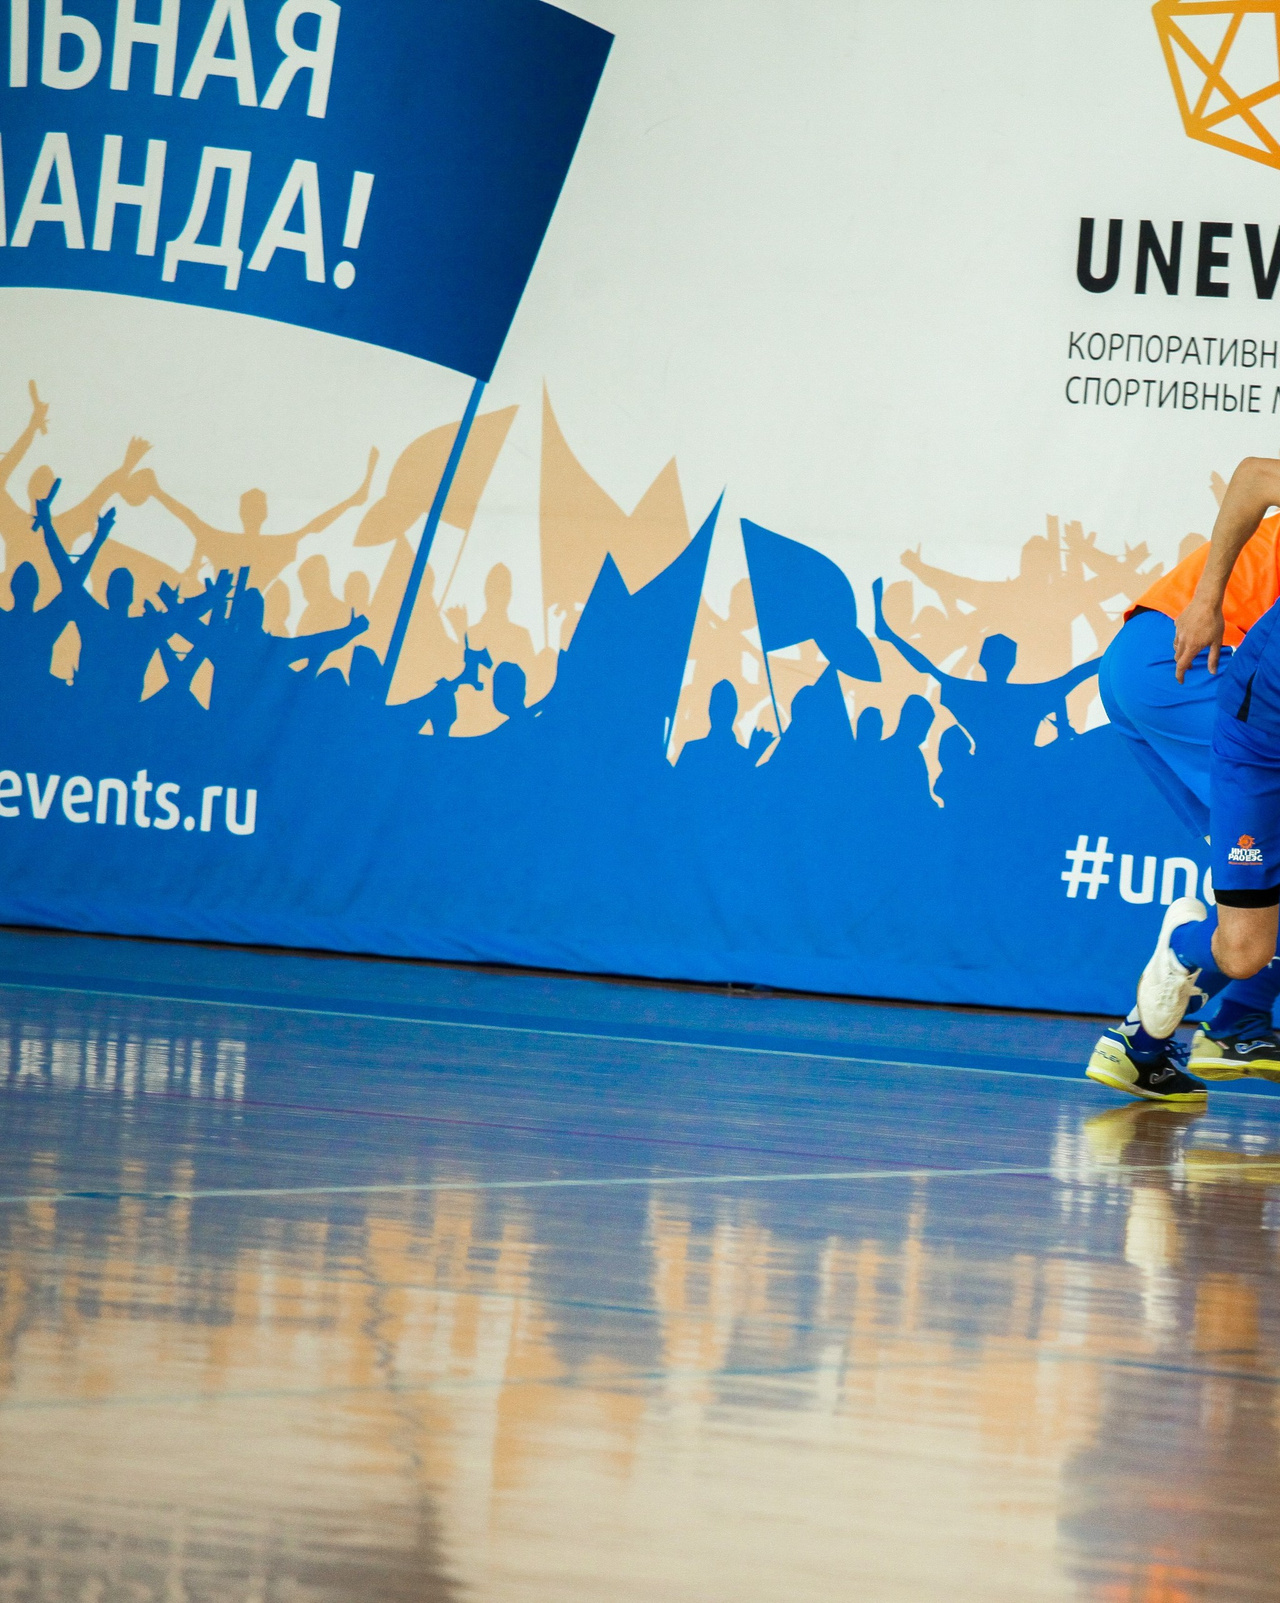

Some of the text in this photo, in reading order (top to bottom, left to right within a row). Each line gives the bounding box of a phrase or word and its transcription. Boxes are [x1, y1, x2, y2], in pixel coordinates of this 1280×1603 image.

[0, 131, 375, 291] АНДА!
[1065, 376, 1262, 414] СПОРТИВНЫЕ
[0, 768, 258, 836] events.ru
[1231, 847, 1261, 856] ИНТЕР
